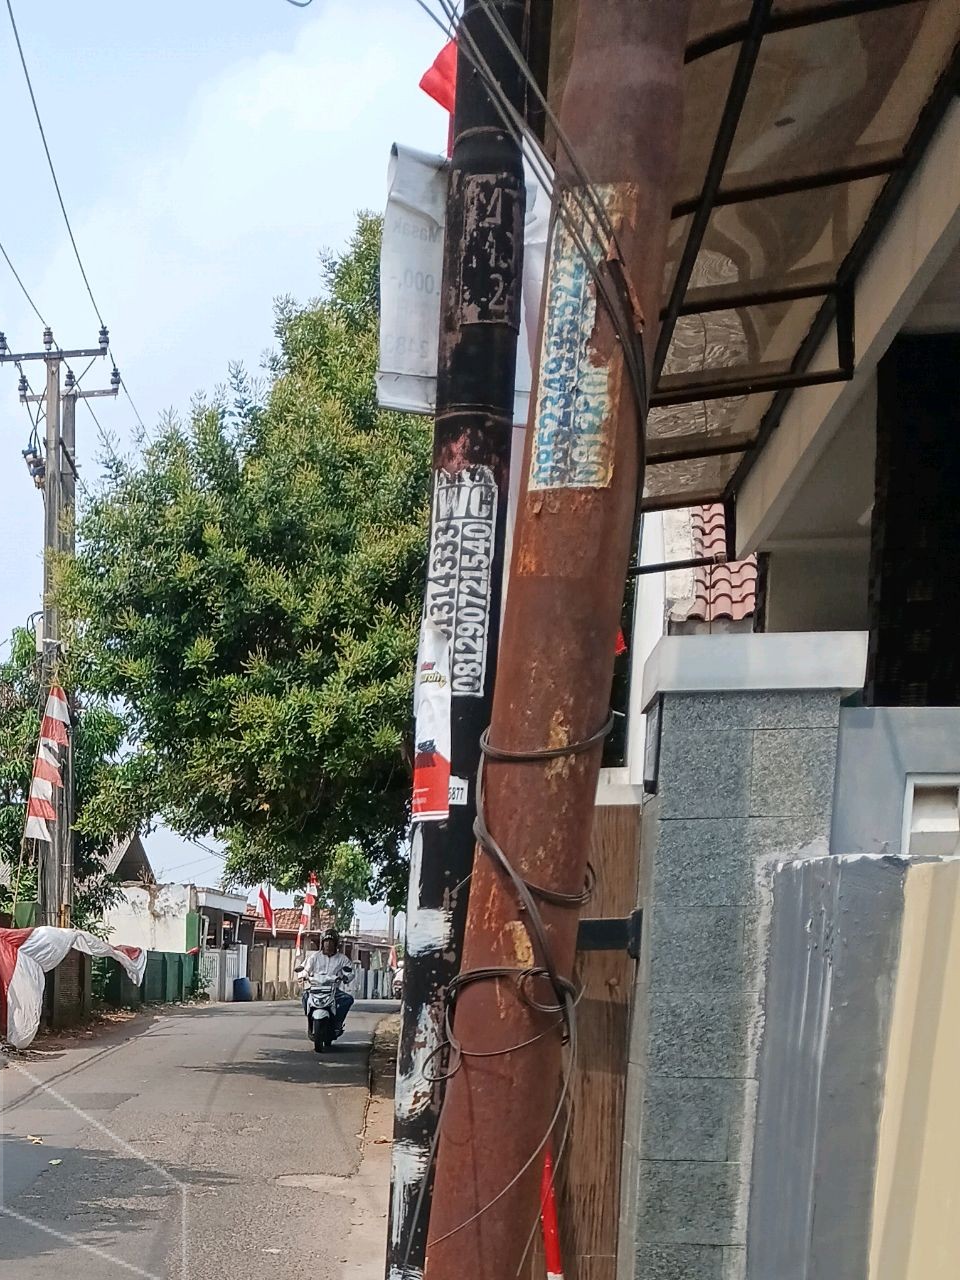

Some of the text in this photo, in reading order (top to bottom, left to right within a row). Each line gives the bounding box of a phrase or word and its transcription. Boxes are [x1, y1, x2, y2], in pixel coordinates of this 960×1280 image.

[437, 485, 493, 519] WC
[426, 524, 461, 662] 1314333
[452, 523, 492, 692] 081290721540
